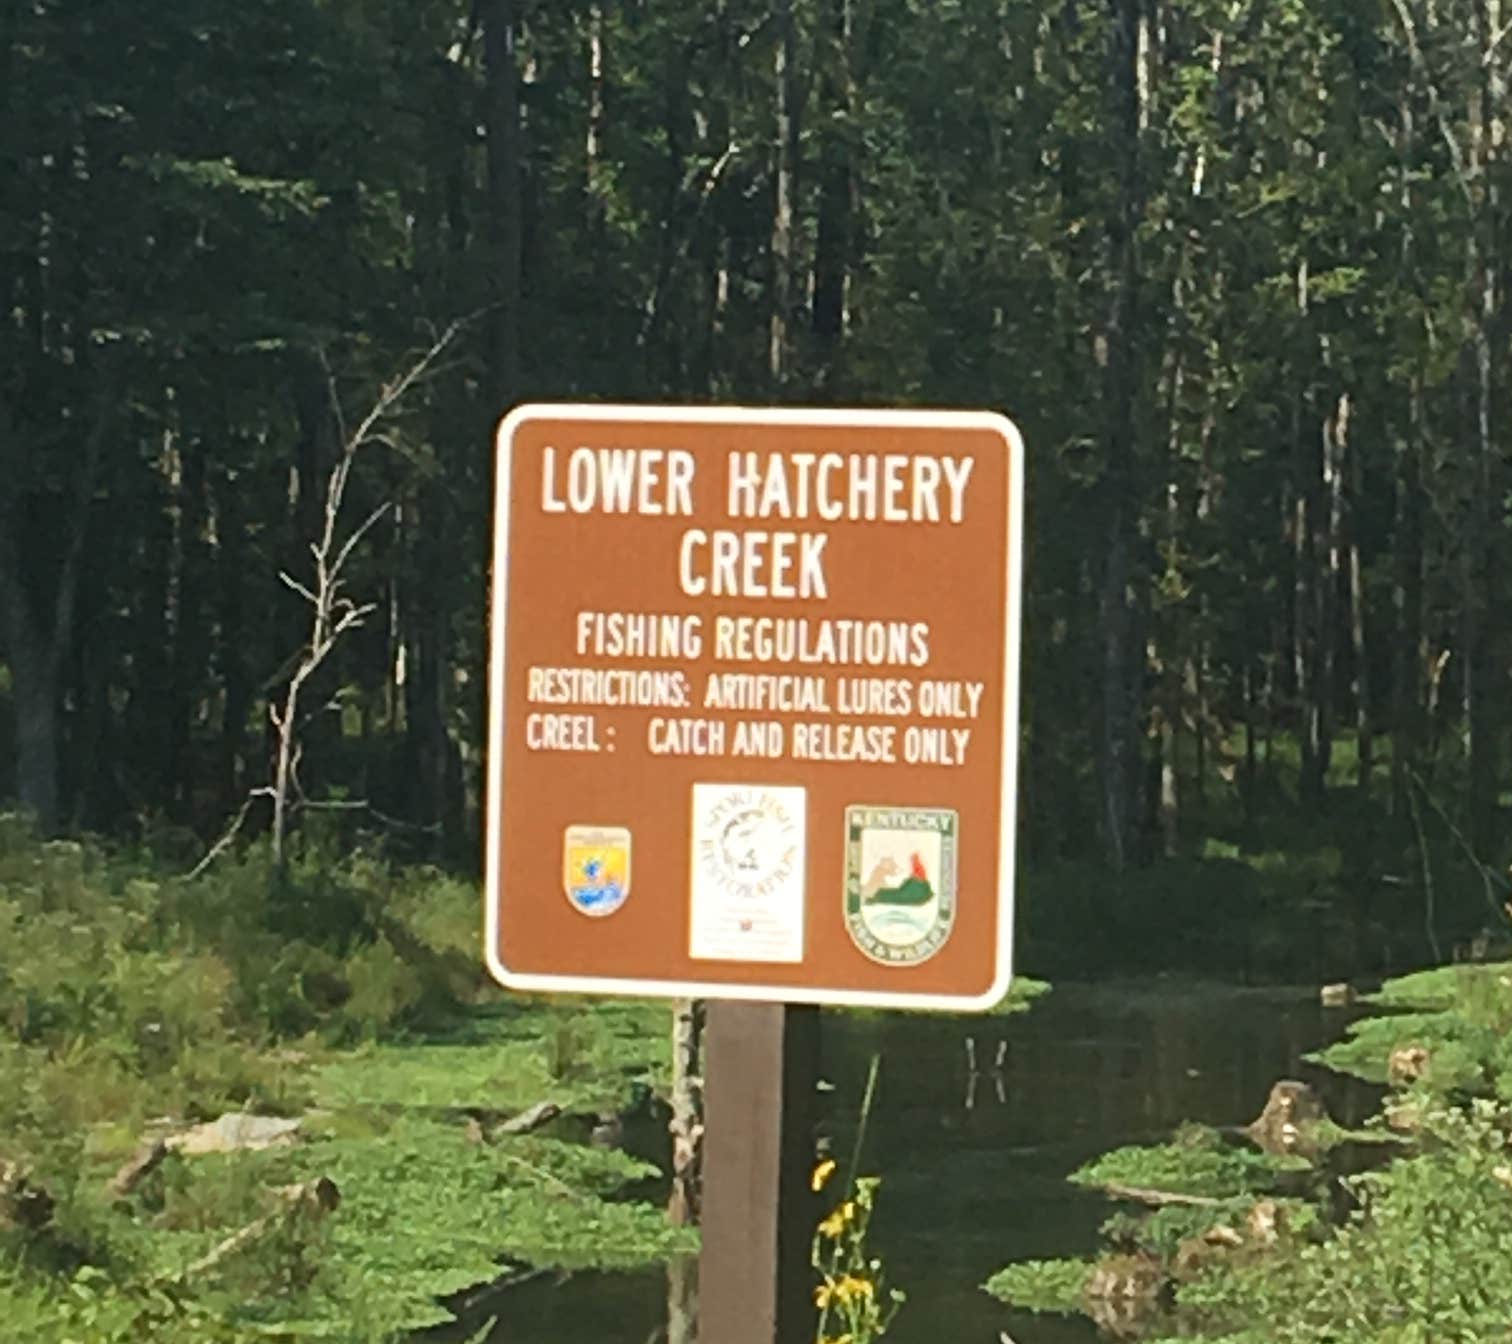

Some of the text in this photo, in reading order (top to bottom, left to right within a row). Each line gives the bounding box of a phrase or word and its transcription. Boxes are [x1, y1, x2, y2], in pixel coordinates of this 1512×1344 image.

[542, 447, 974, 523] LOWER HATCHERY
[680, 529, 828, 599] CREEK
[577, 612, 929, 667] FISHING REGULATIONS
[528, 667, 984, 718] RESTRICTIONS: ARTIFICIAL LURES ONLY
[648, 718, 725, 755] CATCH
[732, 721, 784, 758] AND
[792, 723, 896, 763] RELEASE
[903, 726, 970, 765] ONLY
